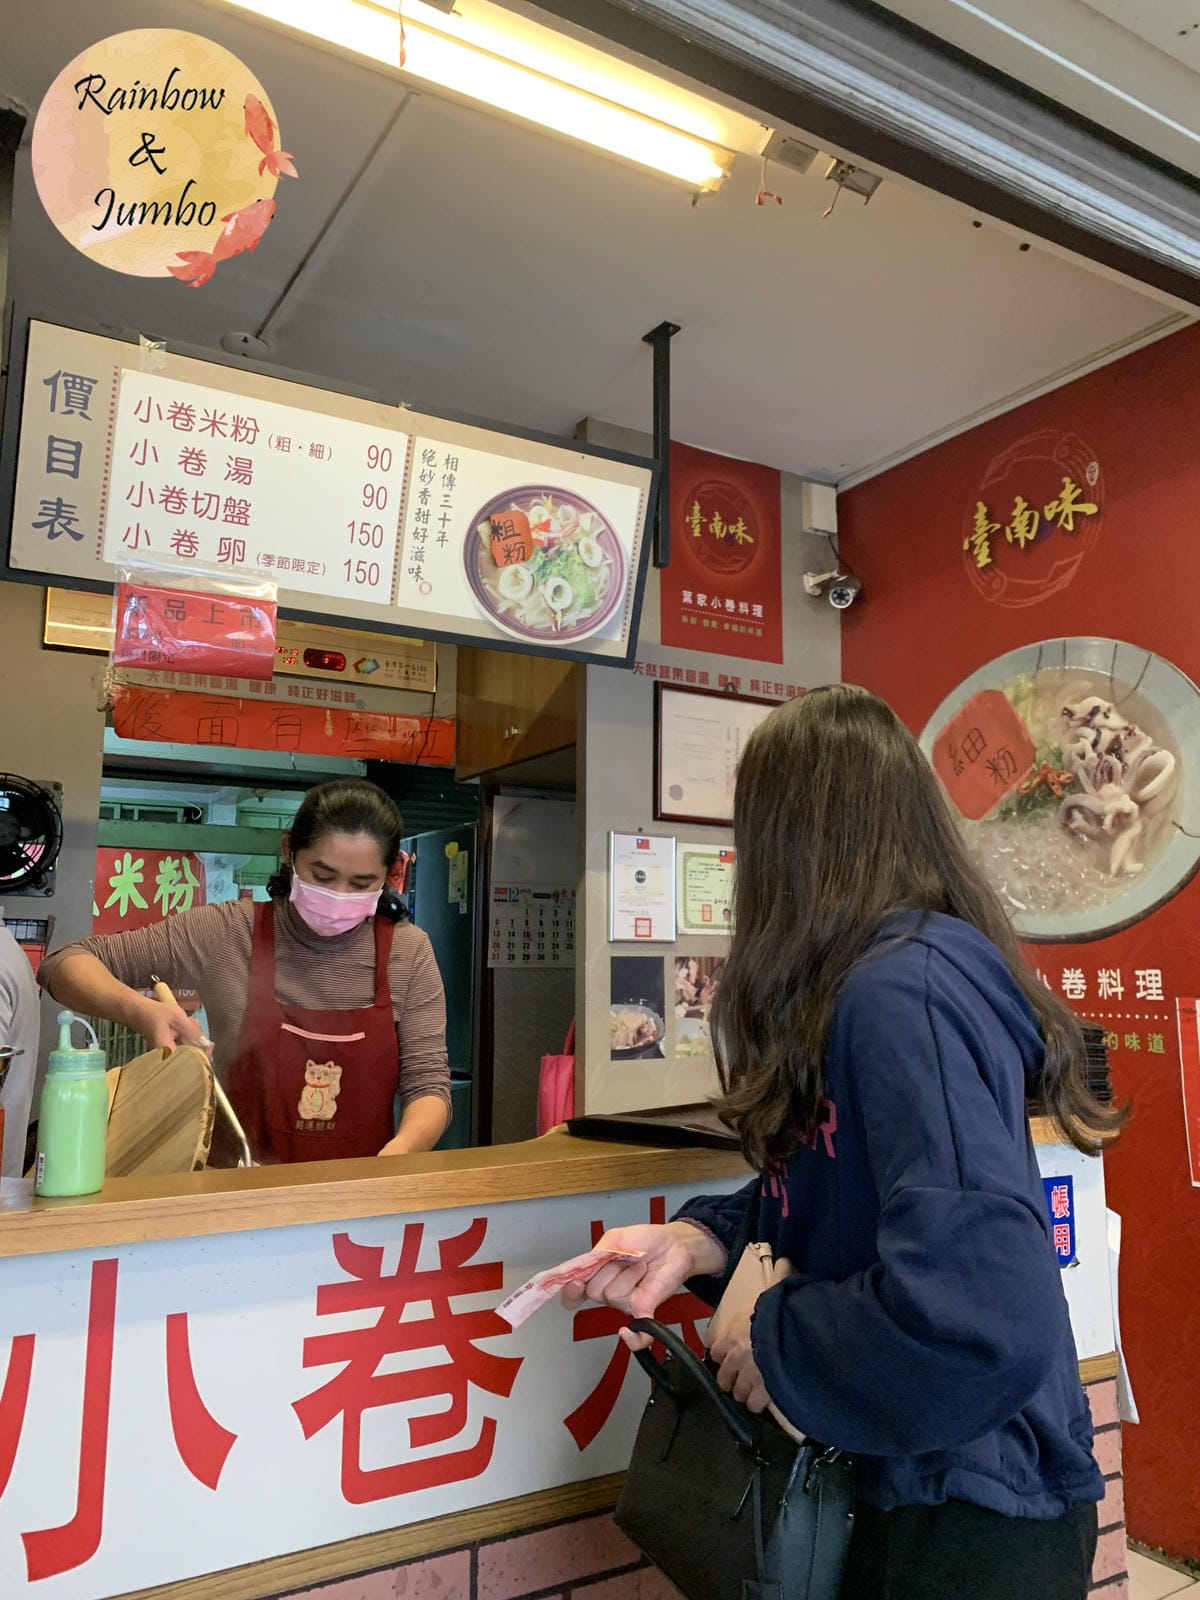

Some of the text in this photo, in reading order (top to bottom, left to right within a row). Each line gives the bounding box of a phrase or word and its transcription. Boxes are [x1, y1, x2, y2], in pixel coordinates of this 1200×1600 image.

[31, 369, 99, 543] 價目表
[133, 395, 260, 445] 小卷米粉
[366, 444, 393, 472] 90
[129, 437, 388, 511] 小卷湯 90
[435, 453, 459, 548] 相傳三十年
[125, 480, 384, 549] 小卷切盤 150
[491, 518, 527, 563] 粗粉
[963, 477, 1099, 568] 臺南味
[121, 522, 246, 566] 小卷卵
[343, 557, 380, 587] 150
[93, 852, 201, 918] 米粉
